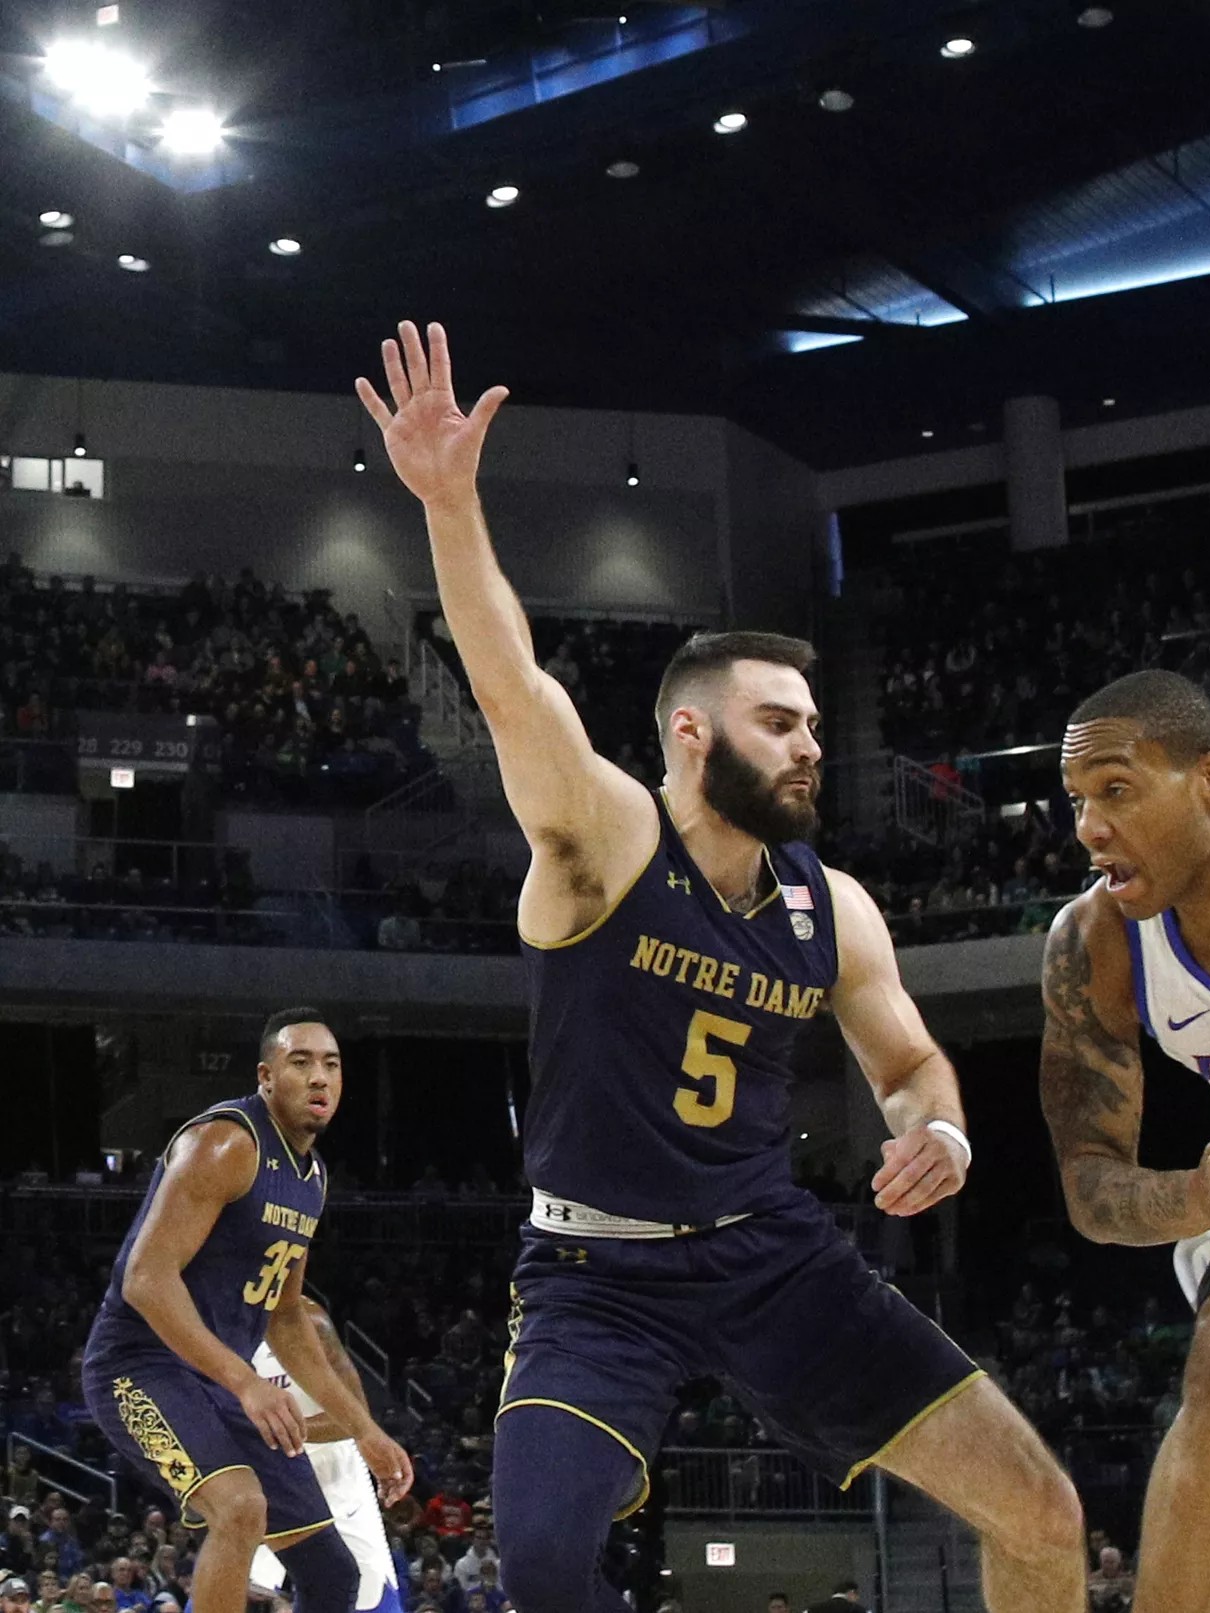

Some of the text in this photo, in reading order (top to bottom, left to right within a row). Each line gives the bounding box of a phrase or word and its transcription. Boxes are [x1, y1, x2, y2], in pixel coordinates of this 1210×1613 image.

[629, 934, 824, 1019] NOTRE DAME
[672, 1009, 752, 1128] 5
[243, 1239, 307, 1311] 35
